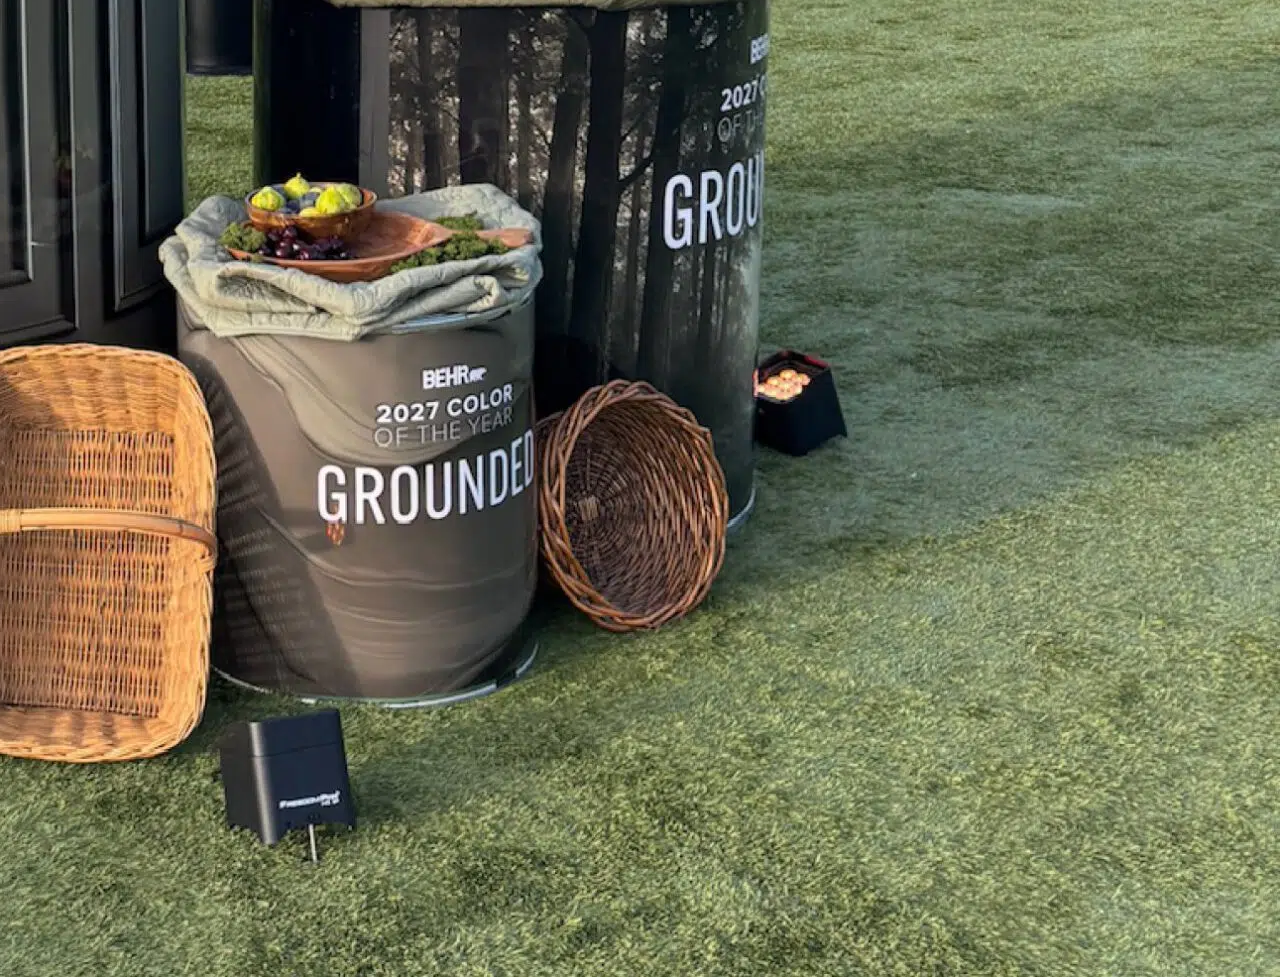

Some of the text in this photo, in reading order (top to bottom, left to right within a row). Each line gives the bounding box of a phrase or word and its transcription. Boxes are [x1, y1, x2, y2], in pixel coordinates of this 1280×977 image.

[721, 79, 758, 112] 2027
[422, 365, 469, 389] BEHR
[376, 383, 513, 423] 2027 COLOR
[374, 406, 513, 448] OF THE YEAR
[317, 428, 535, 525] GROUNDED
